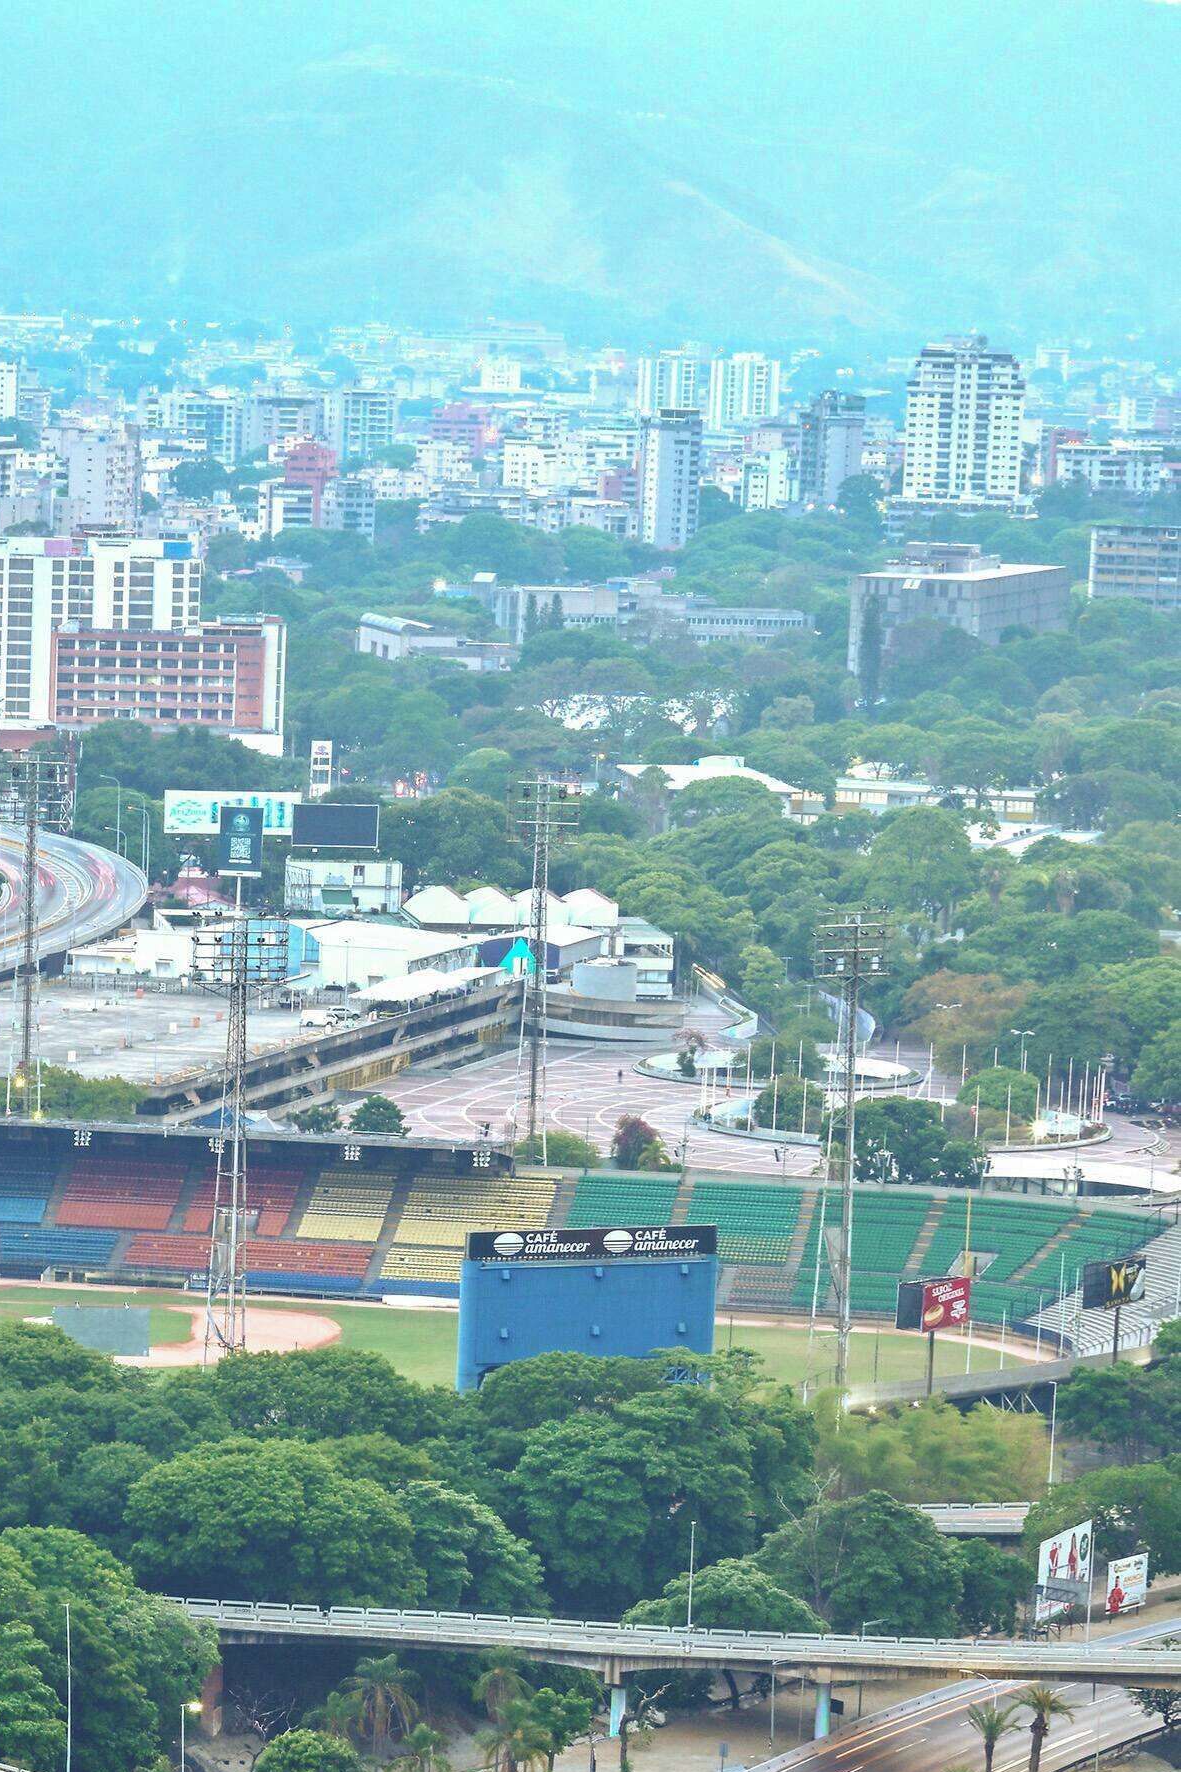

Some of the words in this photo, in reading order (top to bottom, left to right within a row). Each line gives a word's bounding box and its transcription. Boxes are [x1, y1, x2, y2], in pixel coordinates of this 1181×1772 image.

[525, 1230, 558, 1243] CAFÉ
[635, 1228, 667, 1240] CAFÉ
[525, 1242, 590, 1254] amanecer
[634, 1239, 699, 1251] amanecer
